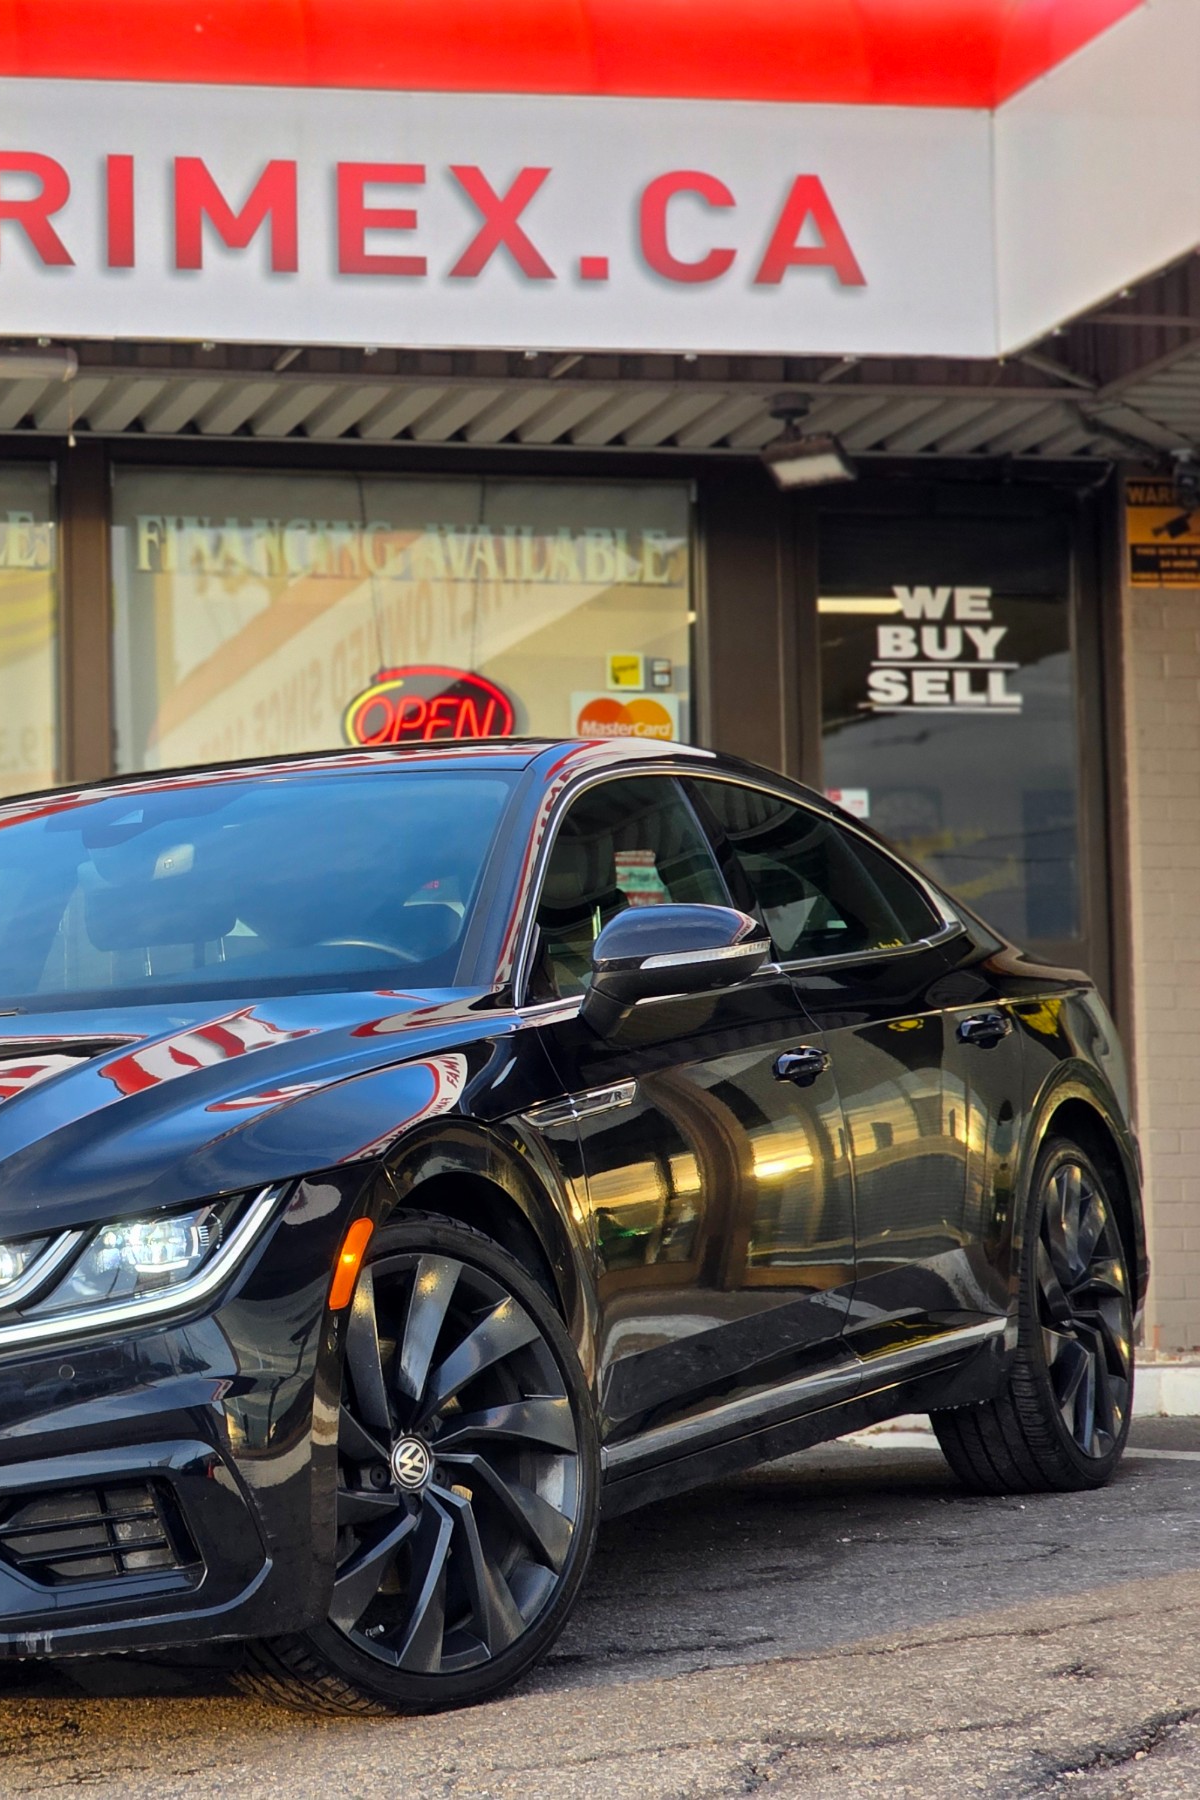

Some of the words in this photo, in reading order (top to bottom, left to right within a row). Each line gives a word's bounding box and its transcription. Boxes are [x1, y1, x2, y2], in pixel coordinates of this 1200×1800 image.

[136, 515, 397, 579] FINANCING
[423, 523, 674, 585] AVAILABLE
[893, 586, 992, 620] WE
[877, 626, 1007, 660] BUY
[867, 669, 1022, 704] SELL
[355, 694, 496, 746] OPEN
[581, 720, 671, 736] MasterCard
